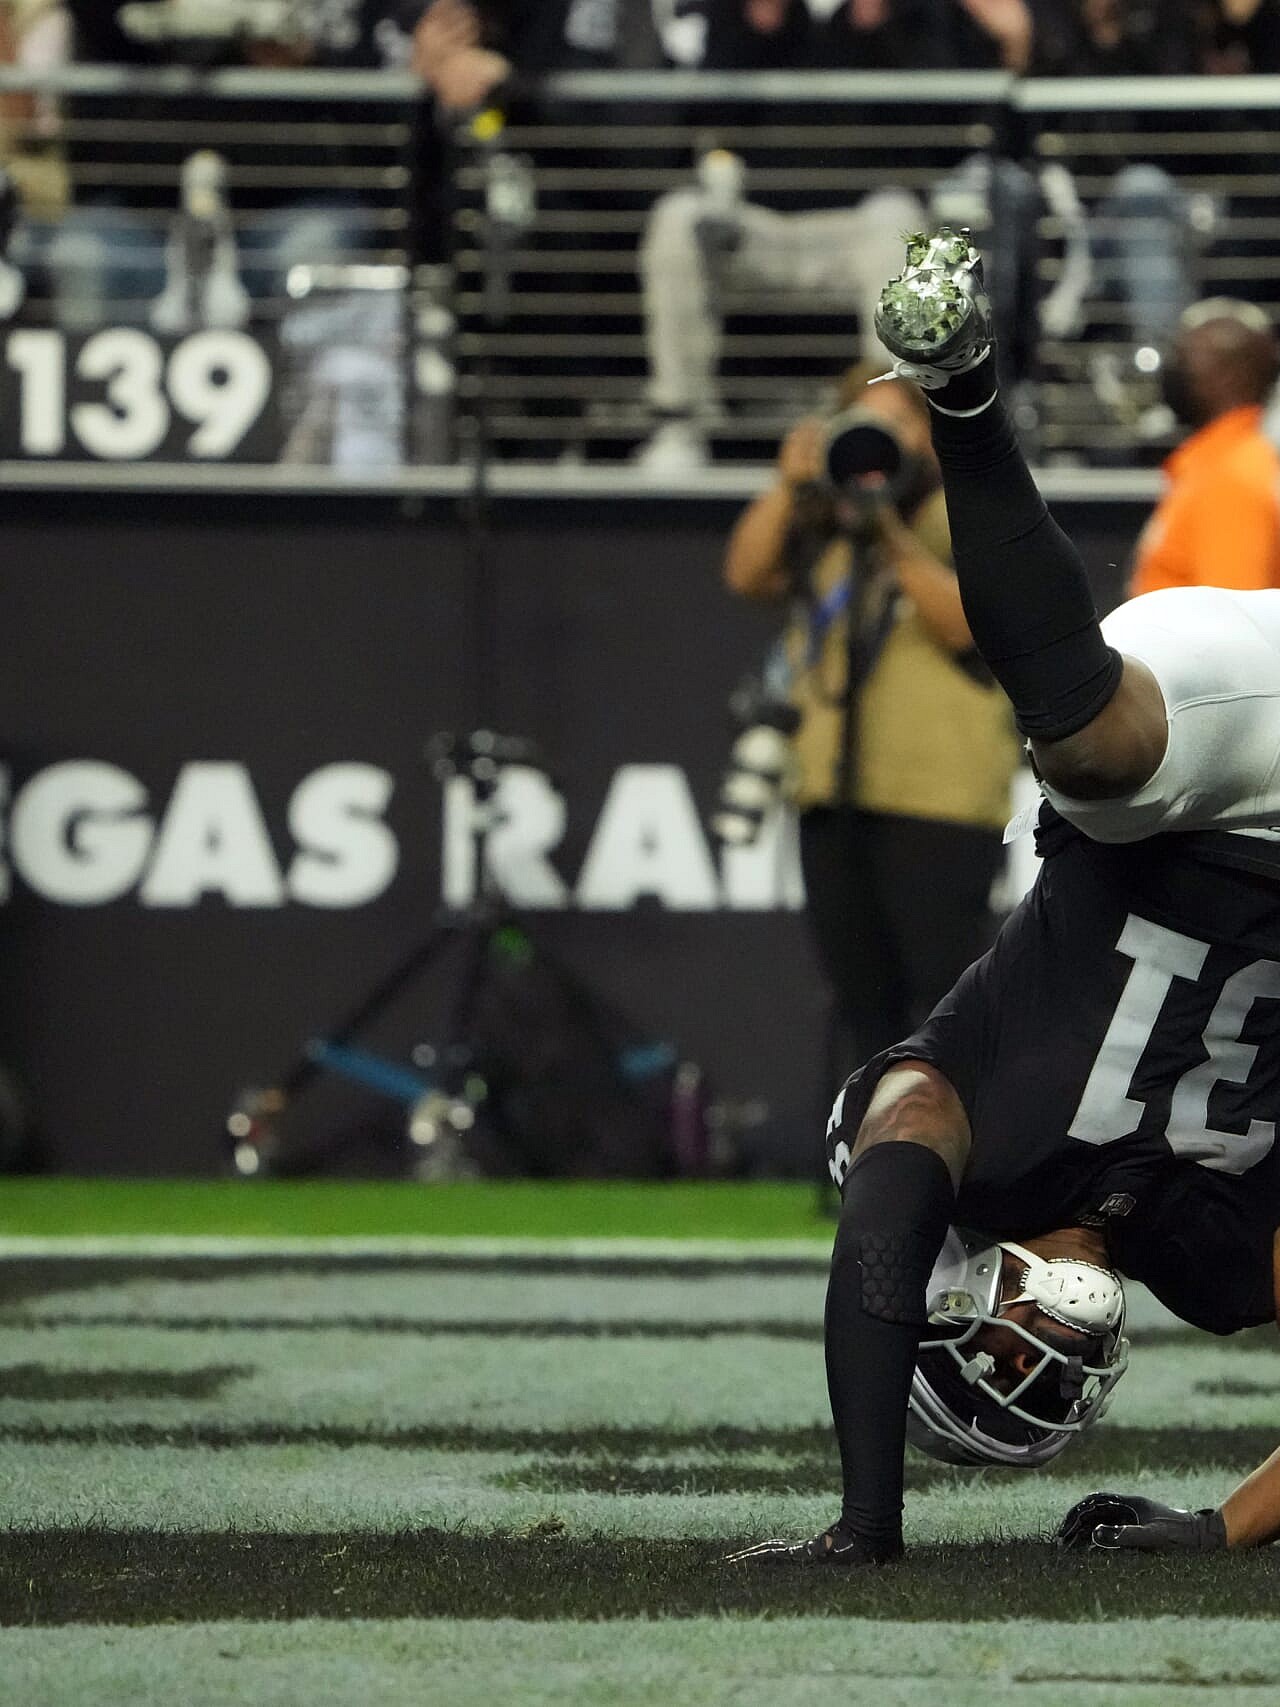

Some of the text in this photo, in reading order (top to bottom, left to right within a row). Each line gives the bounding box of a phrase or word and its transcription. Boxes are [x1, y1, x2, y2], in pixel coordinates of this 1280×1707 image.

[6, 327, 272, 460] 139
[0, 757, 808, 911] GAS RAI
